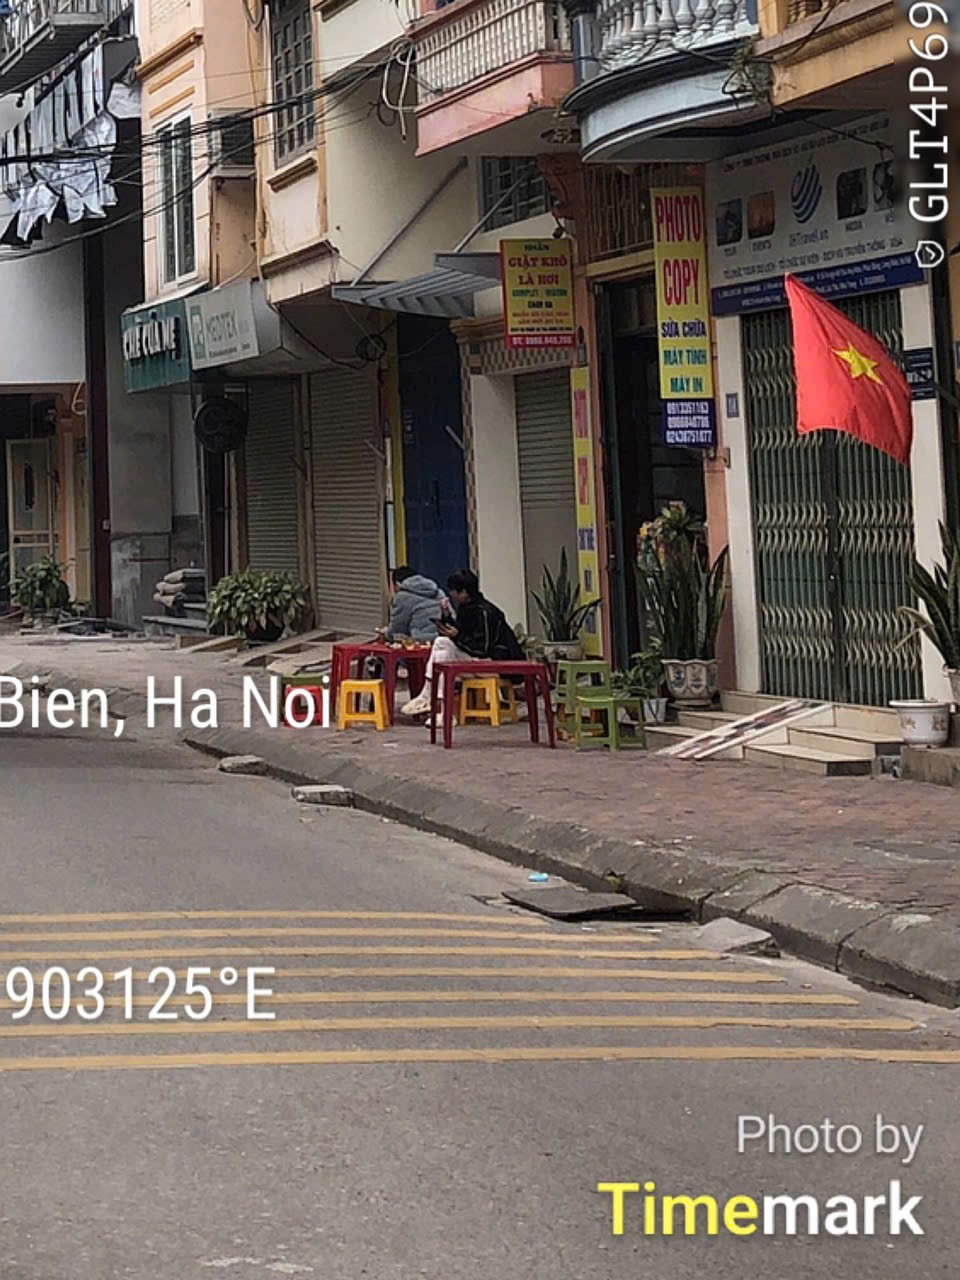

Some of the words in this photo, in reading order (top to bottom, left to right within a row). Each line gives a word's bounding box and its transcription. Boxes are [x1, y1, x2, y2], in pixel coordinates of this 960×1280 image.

[654, 195, 701, 242] PHOTO
[663, 258, 699, 305] COPY
[661, 316, 681, 338] SỬA
[682, 317, 707, 338] CHỮA
[670, 374, 690, 393] MÁY
[692, 376, 704, 393] IN
